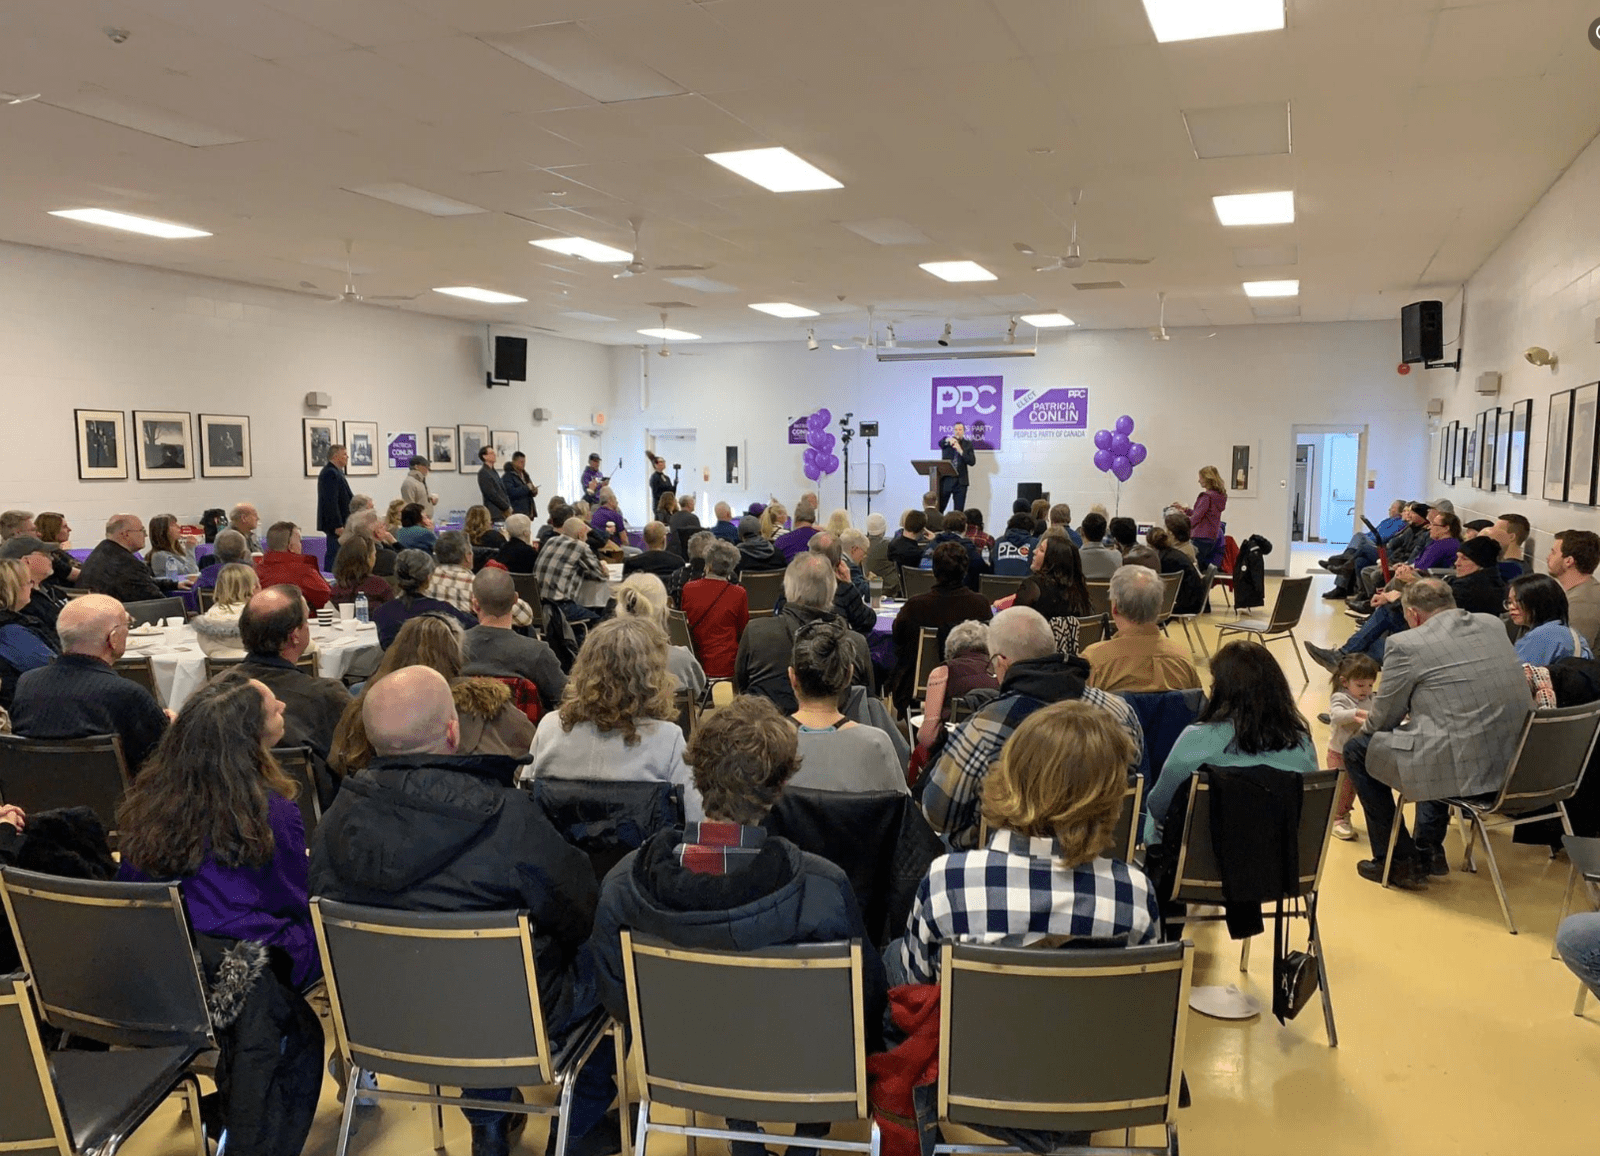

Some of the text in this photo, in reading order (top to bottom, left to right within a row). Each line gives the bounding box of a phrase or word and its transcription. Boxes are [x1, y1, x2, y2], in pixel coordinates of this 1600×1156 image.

[1068, 390, 1086, 398] PPC
[936, 385, 996, 414] PPC
[1016, 390, 1036, 409] ELECT
[1033, 402, 1075, 411] PATRICIA
[1029, 410, 1079, 422] CONLIN
[971, 425, 993, 433] PARTY
[1014, 430, 1037, 438] PEOPLE'S
[1039, 430, 1054, 438] PARTY
[998, 542, 1030, 558] PPC
